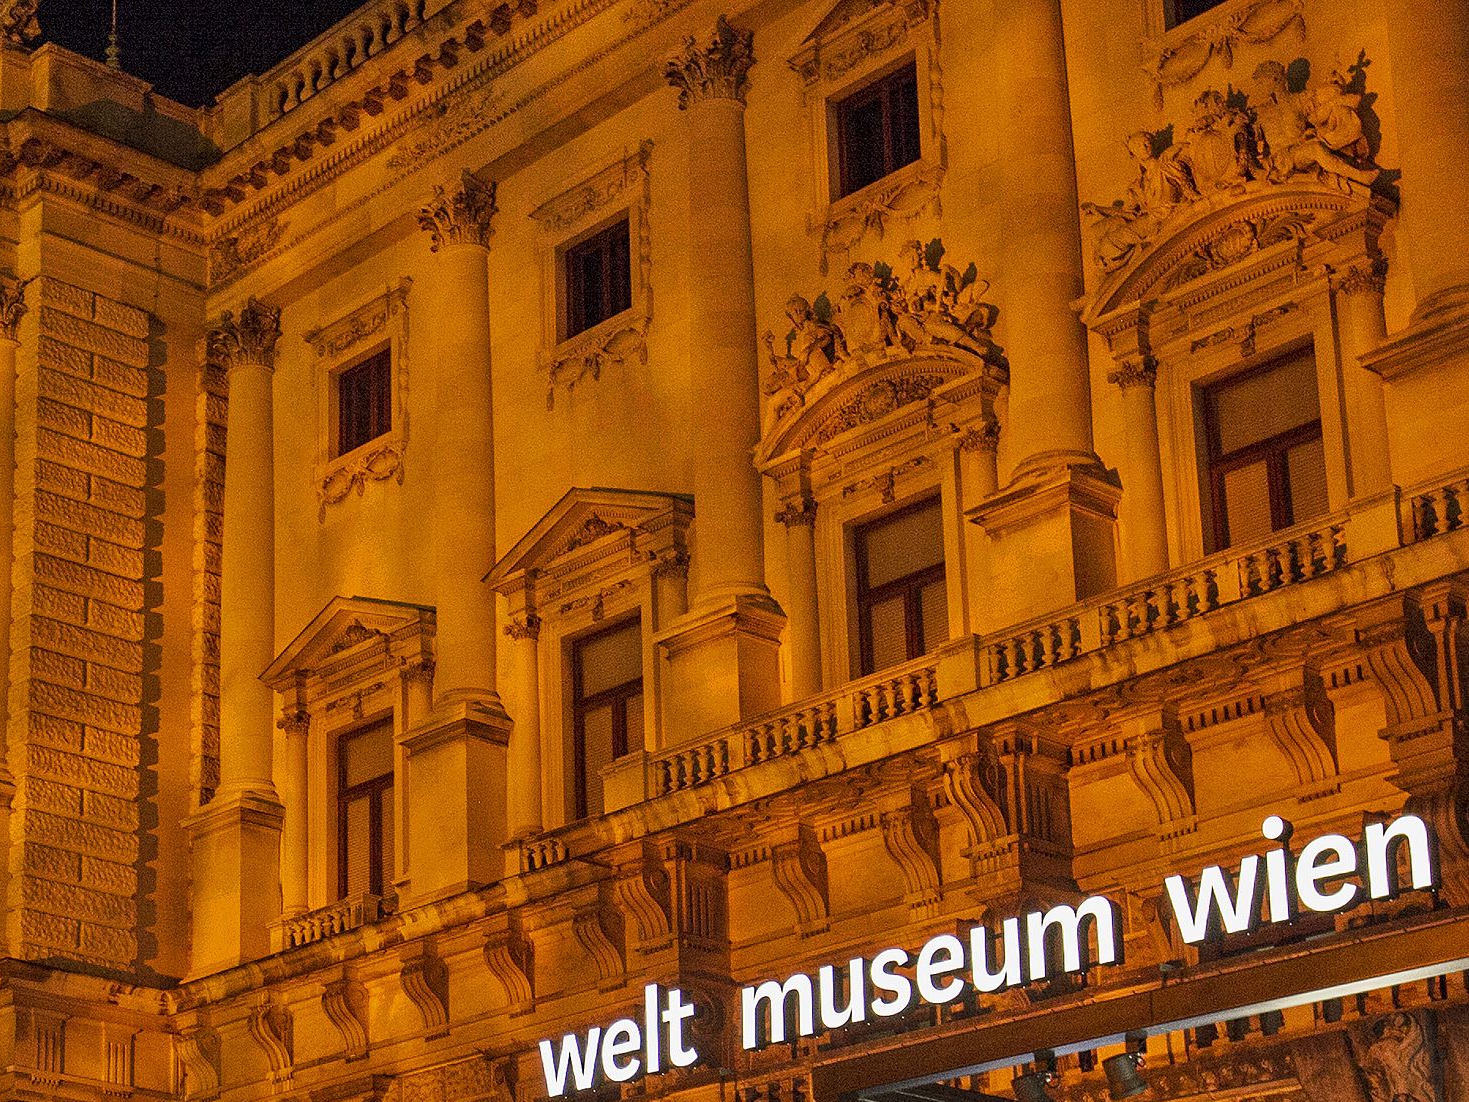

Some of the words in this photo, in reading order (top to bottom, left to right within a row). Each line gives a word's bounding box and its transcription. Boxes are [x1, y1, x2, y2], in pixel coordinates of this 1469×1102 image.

[538, 982, 700, 1099] welt
[741, 894, 1117, 1051] museum
[1163, 814, 1434, 945] wien
